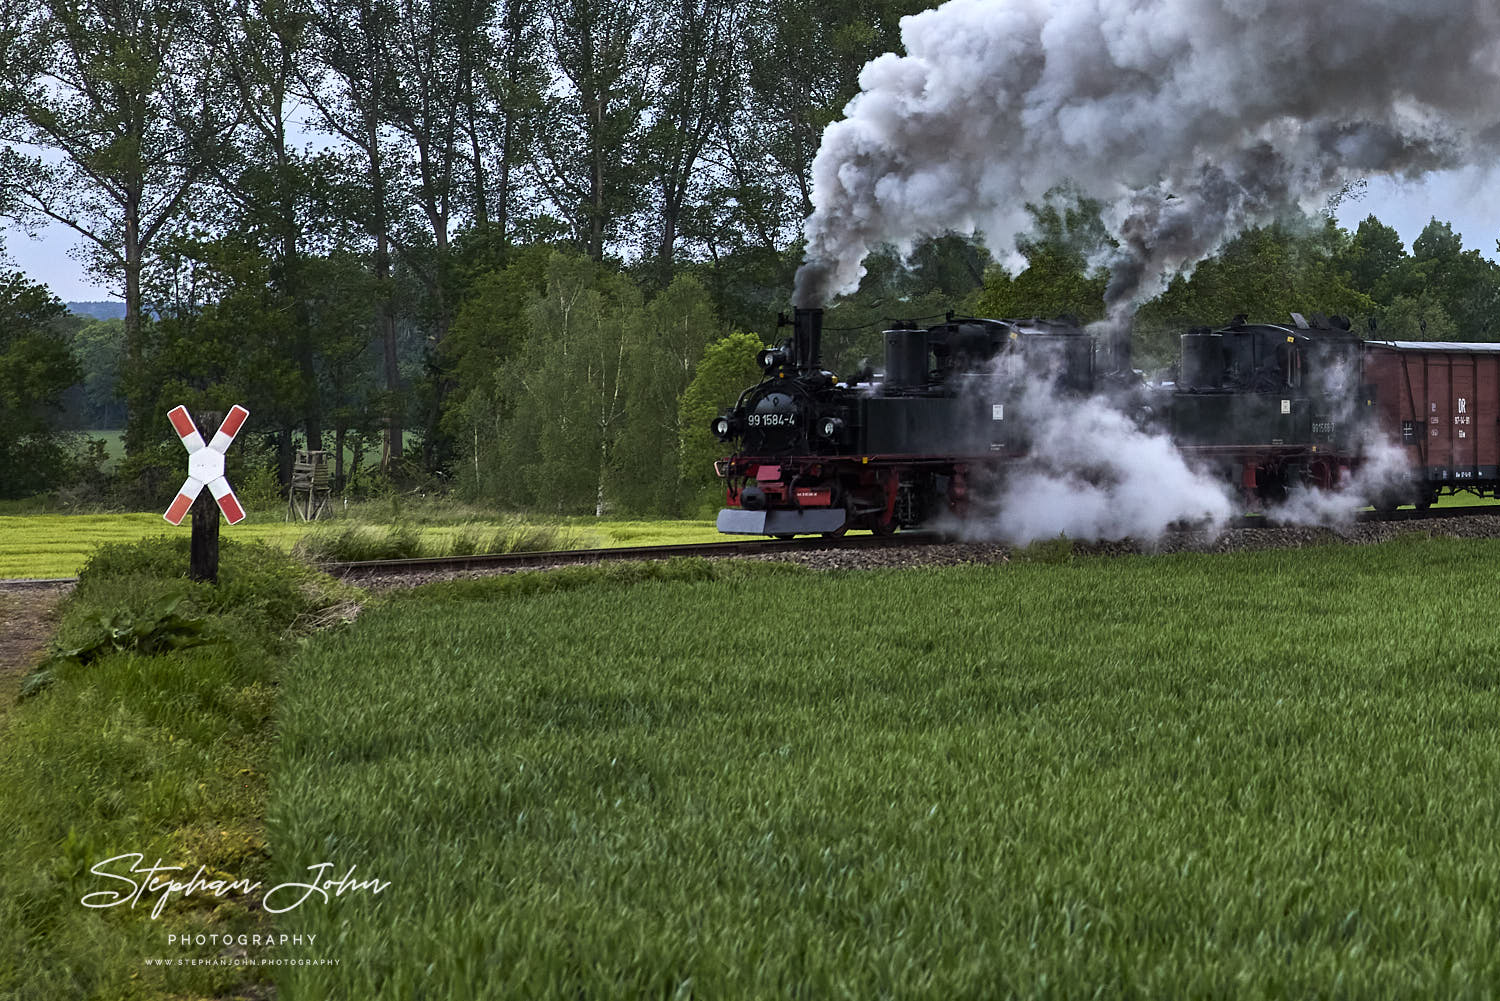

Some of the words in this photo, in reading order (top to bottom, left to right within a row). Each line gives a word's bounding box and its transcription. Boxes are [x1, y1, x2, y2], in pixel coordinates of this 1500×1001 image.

[1458, 398, 1466, 414] DR
[748, 414, 761, 426] 99
[762, 413, 795, 426] 1584-4
